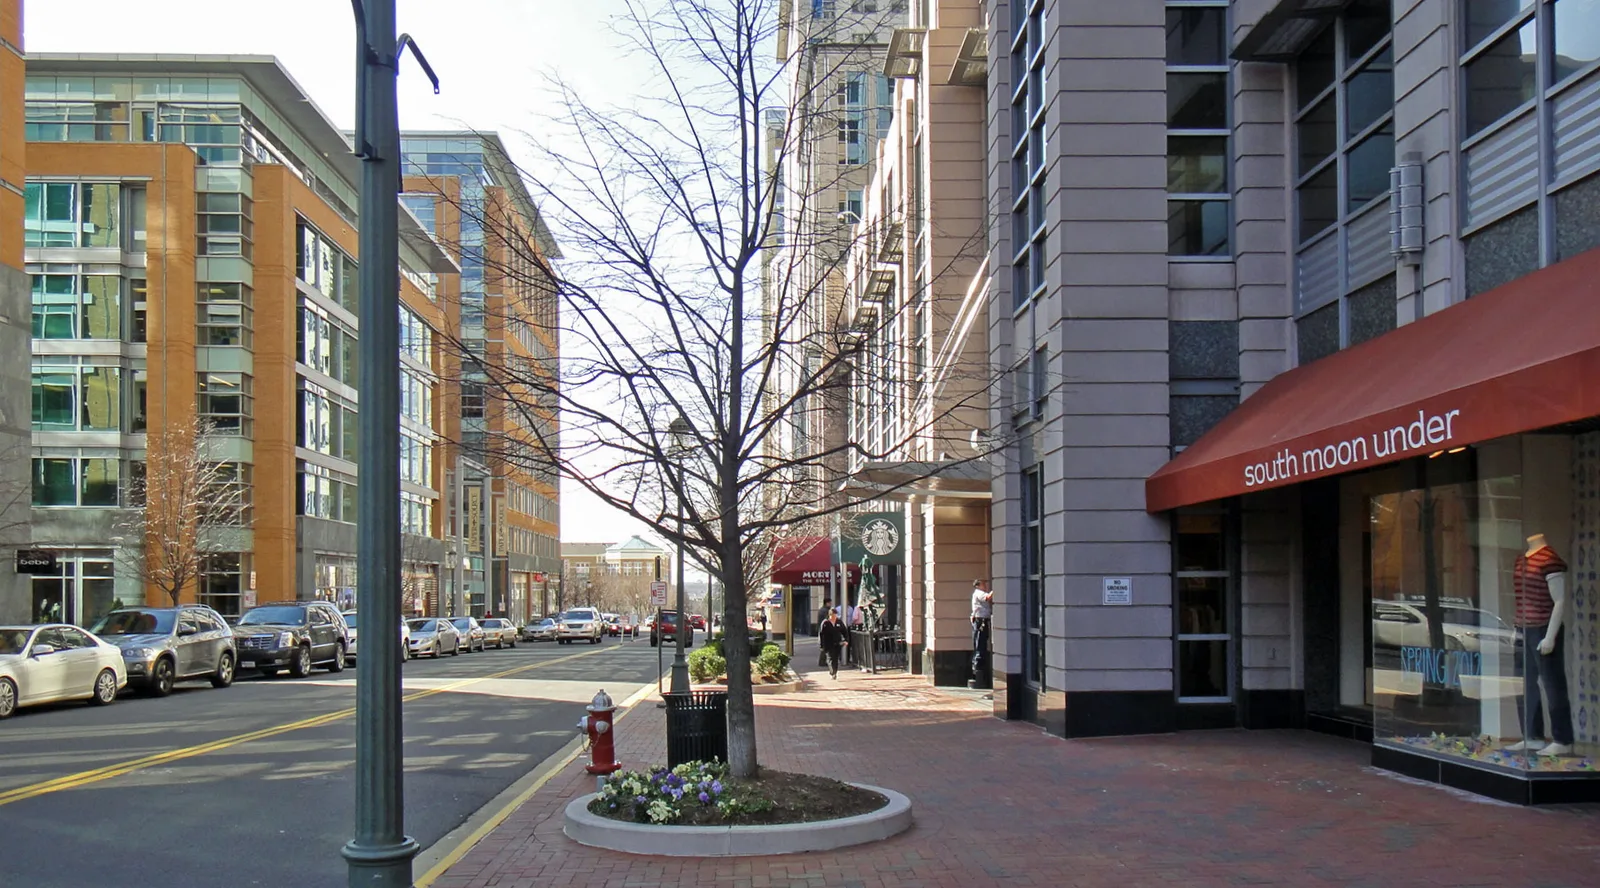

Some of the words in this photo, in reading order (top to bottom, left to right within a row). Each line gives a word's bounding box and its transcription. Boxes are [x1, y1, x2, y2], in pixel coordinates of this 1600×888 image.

[1244, 448, 1299, 487] south
[1302, 436, 1368, 474] moon
[1372, 409, 1460, 459] under
[1400, 646, 1448, 684] SPRING
